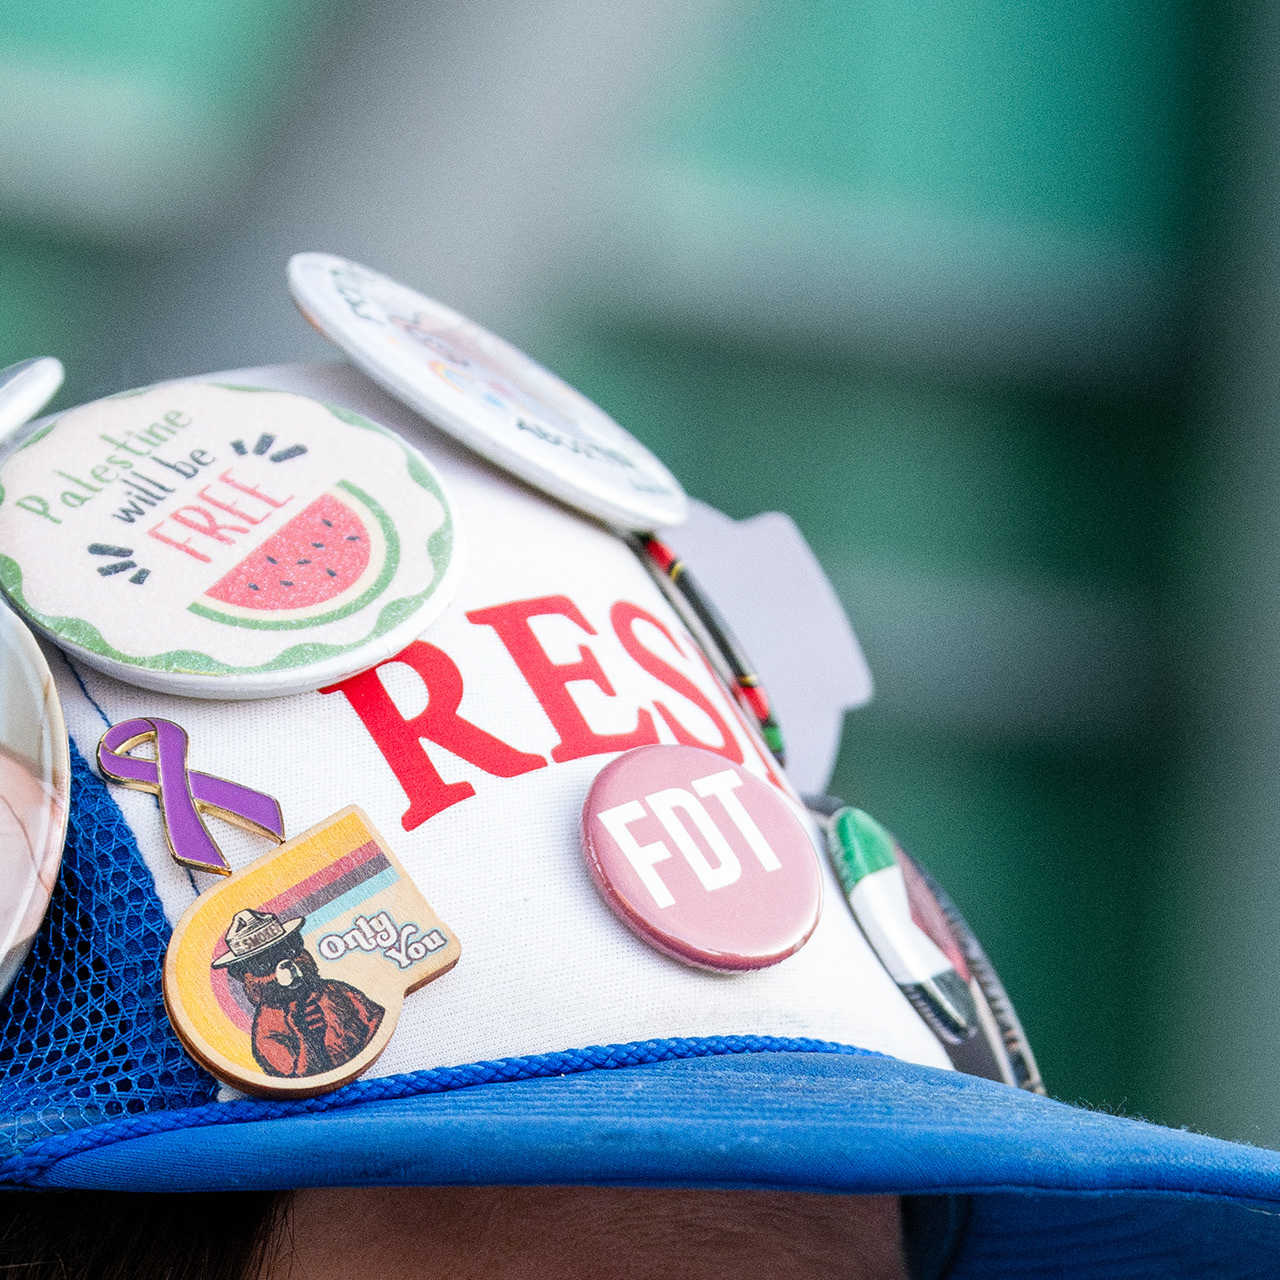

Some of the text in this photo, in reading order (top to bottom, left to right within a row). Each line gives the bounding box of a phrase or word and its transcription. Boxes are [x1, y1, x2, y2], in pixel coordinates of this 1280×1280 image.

[15, 408, 193, 524] Palestine
[111, 448, 216, 524] will be
[147, 467, 294, 564] FREE
[597, 768, 783, 910] FDT
[319, 910, 401, 961] Only
[384, 926, 447, 970] You
